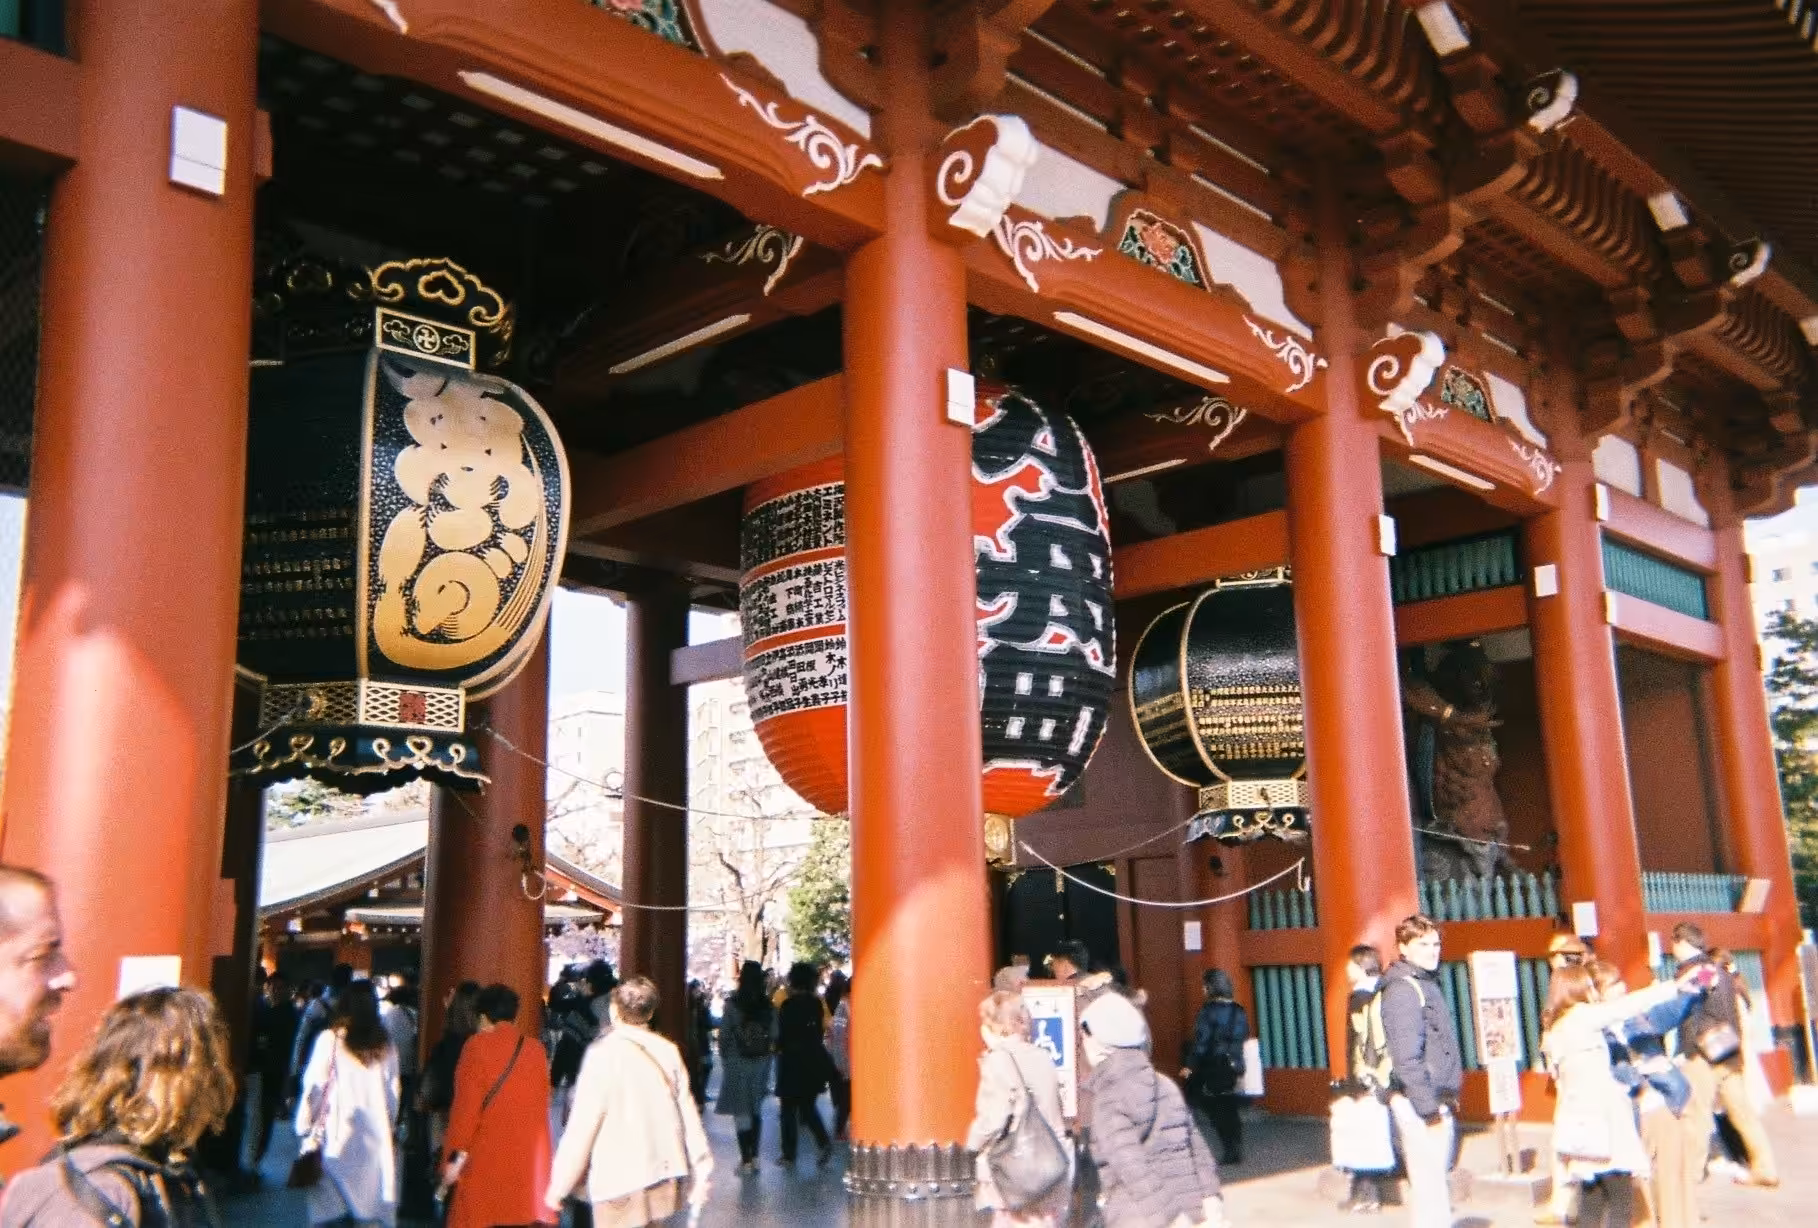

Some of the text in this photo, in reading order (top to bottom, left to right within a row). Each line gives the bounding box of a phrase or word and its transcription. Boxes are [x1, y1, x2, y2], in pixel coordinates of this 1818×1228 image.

[823, 486, 833, 548] エミネント
